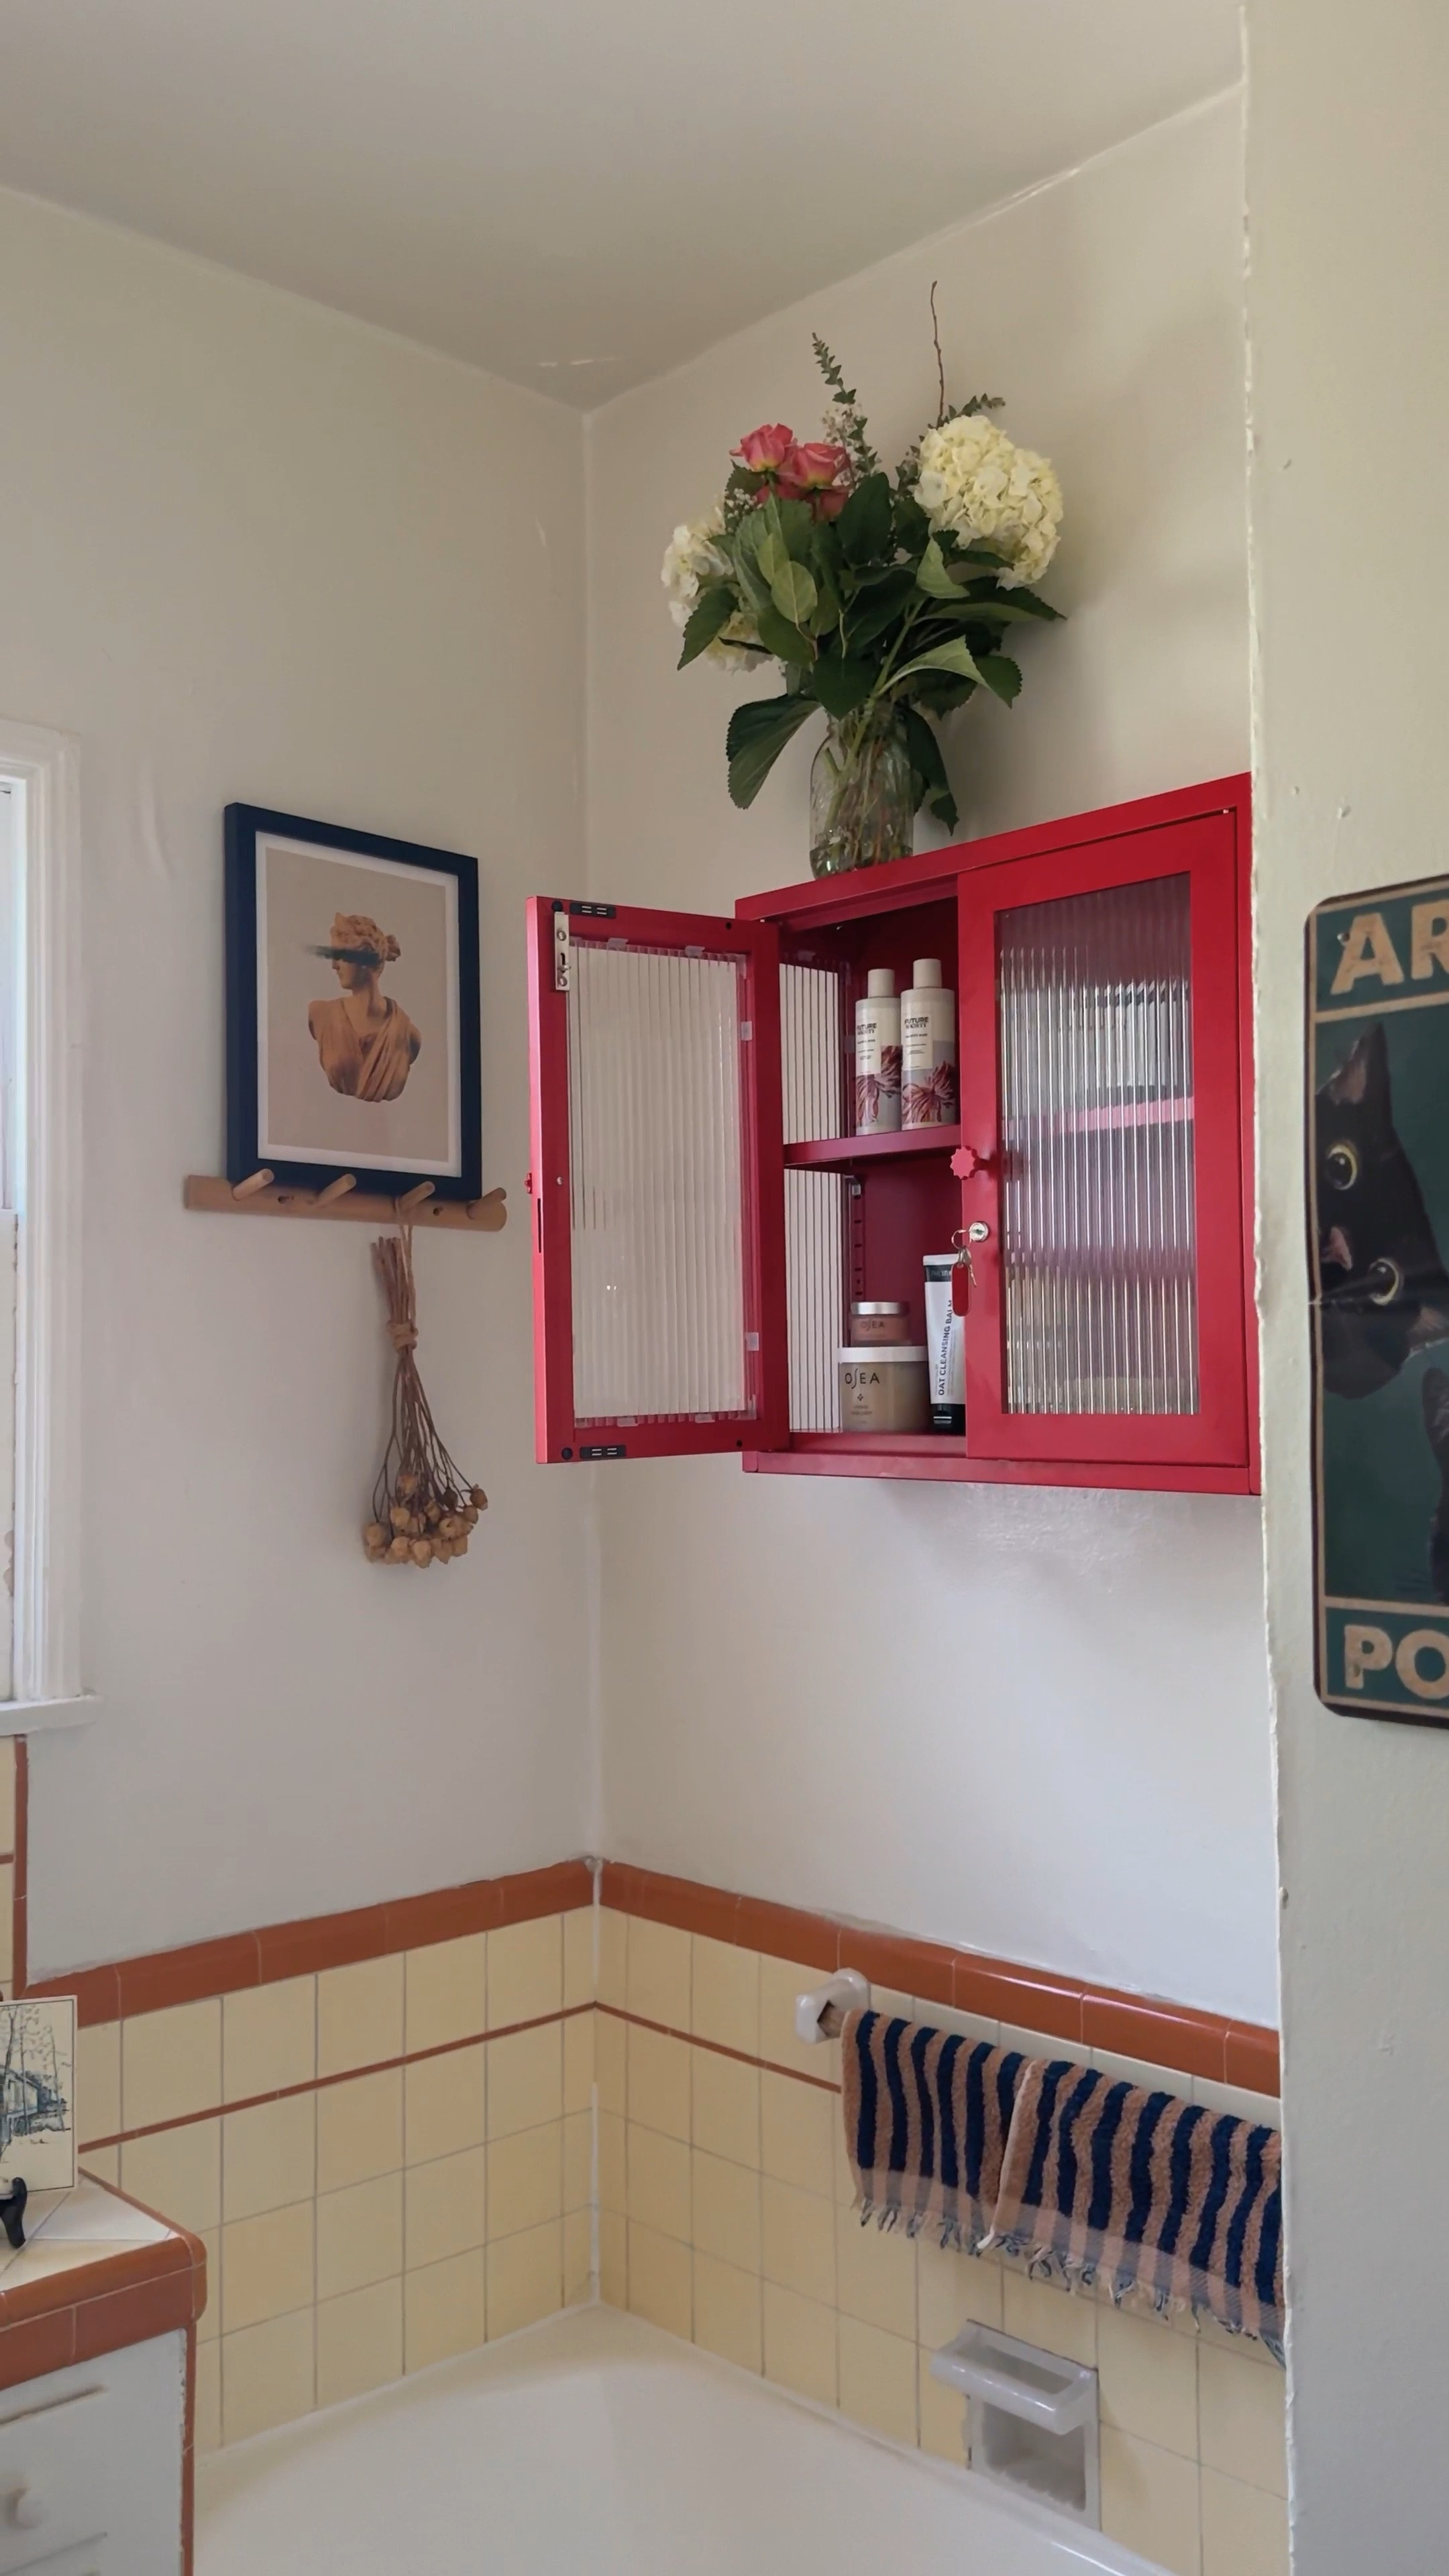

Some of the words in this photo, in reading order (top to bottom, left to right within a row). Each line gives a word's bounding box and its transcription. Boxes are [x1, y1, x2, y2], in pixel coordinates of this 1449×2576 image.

[904, 1016, 928, 1024] FUTURE
[939, 1326, 951, 1376] CLEANSING
[845, 1368, 880, 1389] OSEA
